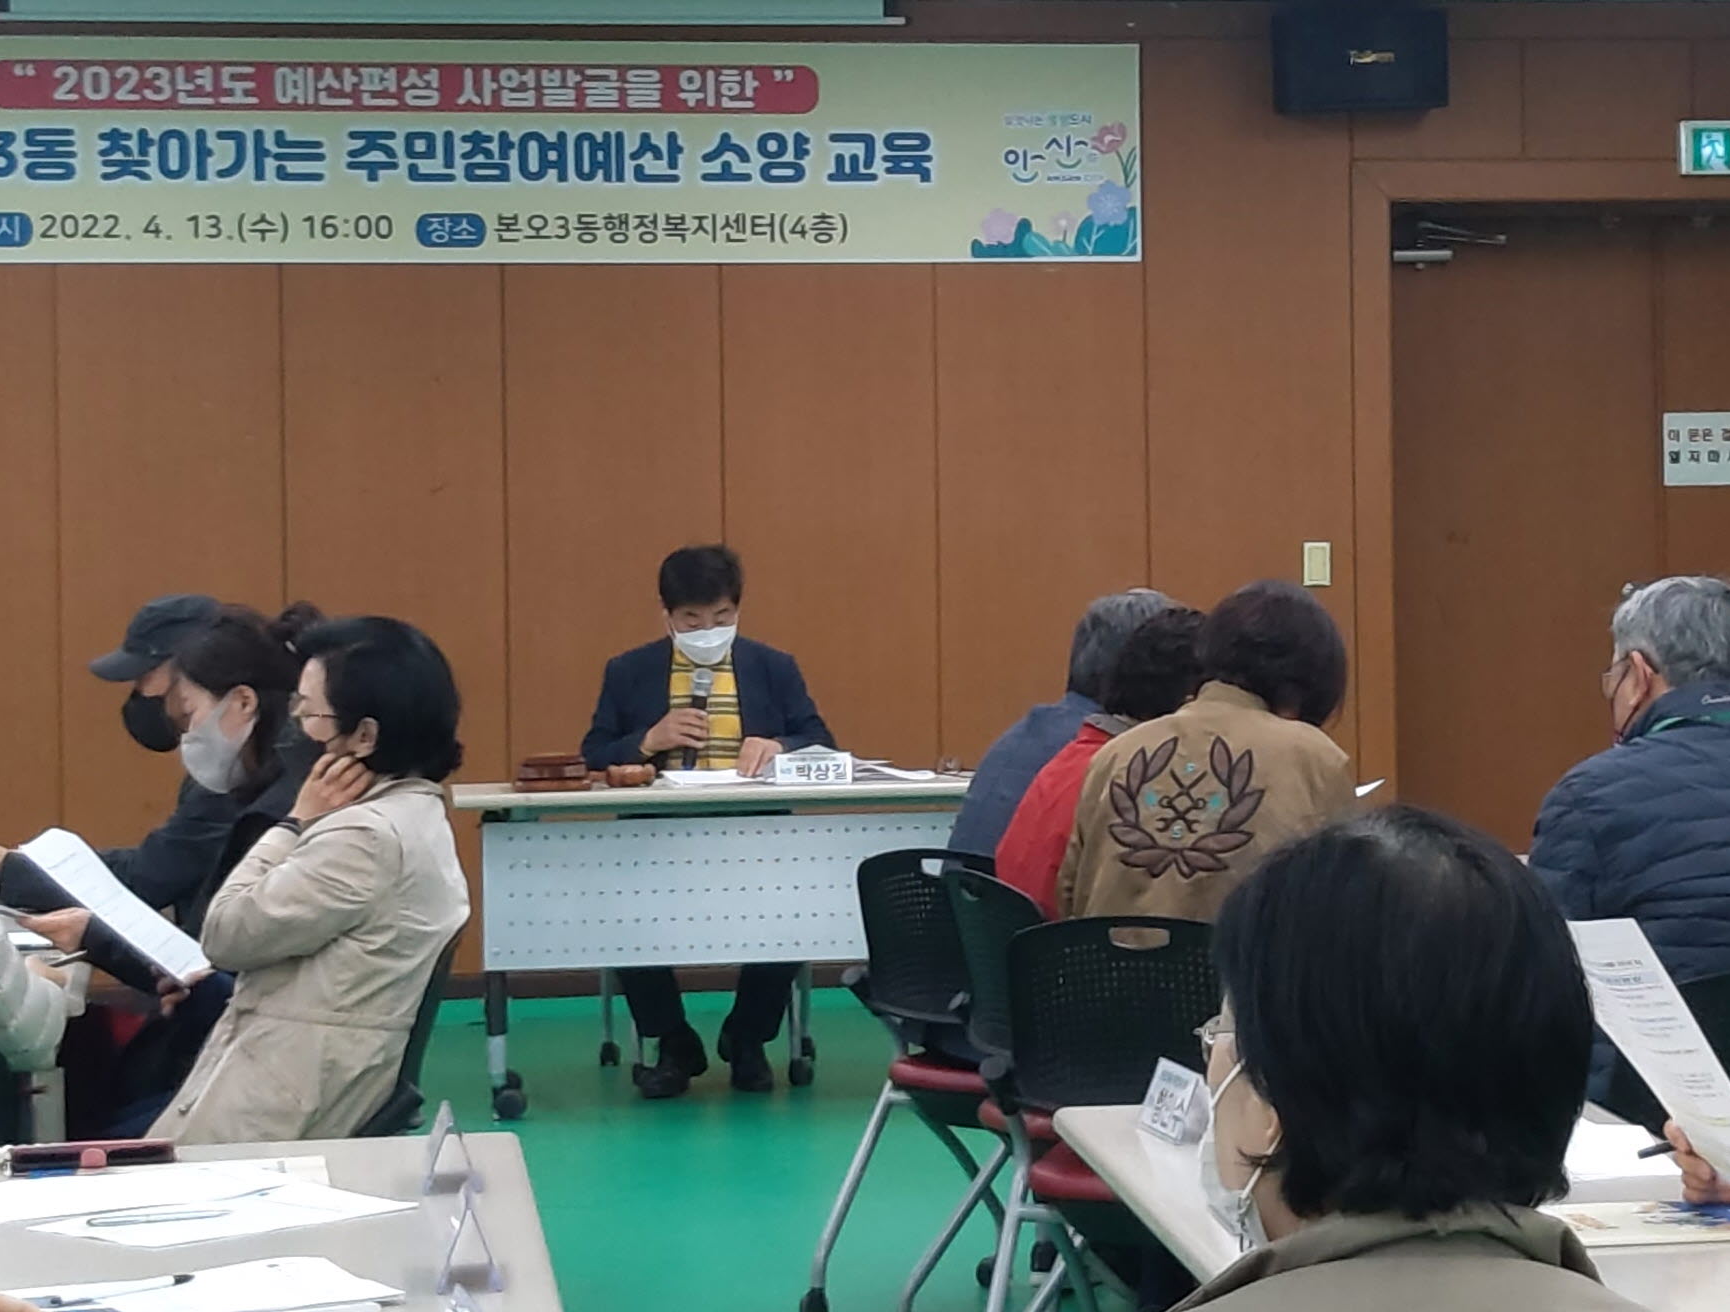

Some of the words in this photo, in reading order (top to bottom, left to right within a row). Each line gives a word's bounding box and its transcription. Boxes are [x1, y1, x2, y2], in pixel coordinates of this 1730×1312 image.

[52, 65, 260, 104] 2023년도
[274, 66, 440, 106] 예산편성
[457, 68, 663, 108] 사업발굴을
[677, 69, 760, 108] 위한
[98, 127, 327, 182] 찾아가는
[346, 129, 684, 184] 주민참여예산
[700, 131, 811, 184] 소양
[827, 131, 934, 184] 교육
[38, 213, 132, 240] 2022.
[142, 214, 173, 240] 4.
[302, 214, 394, 241] 16:00
[426, 217, 478, 242] 장소
[493, 212, 850, 245] 본오3동행정복지센터(4층)
